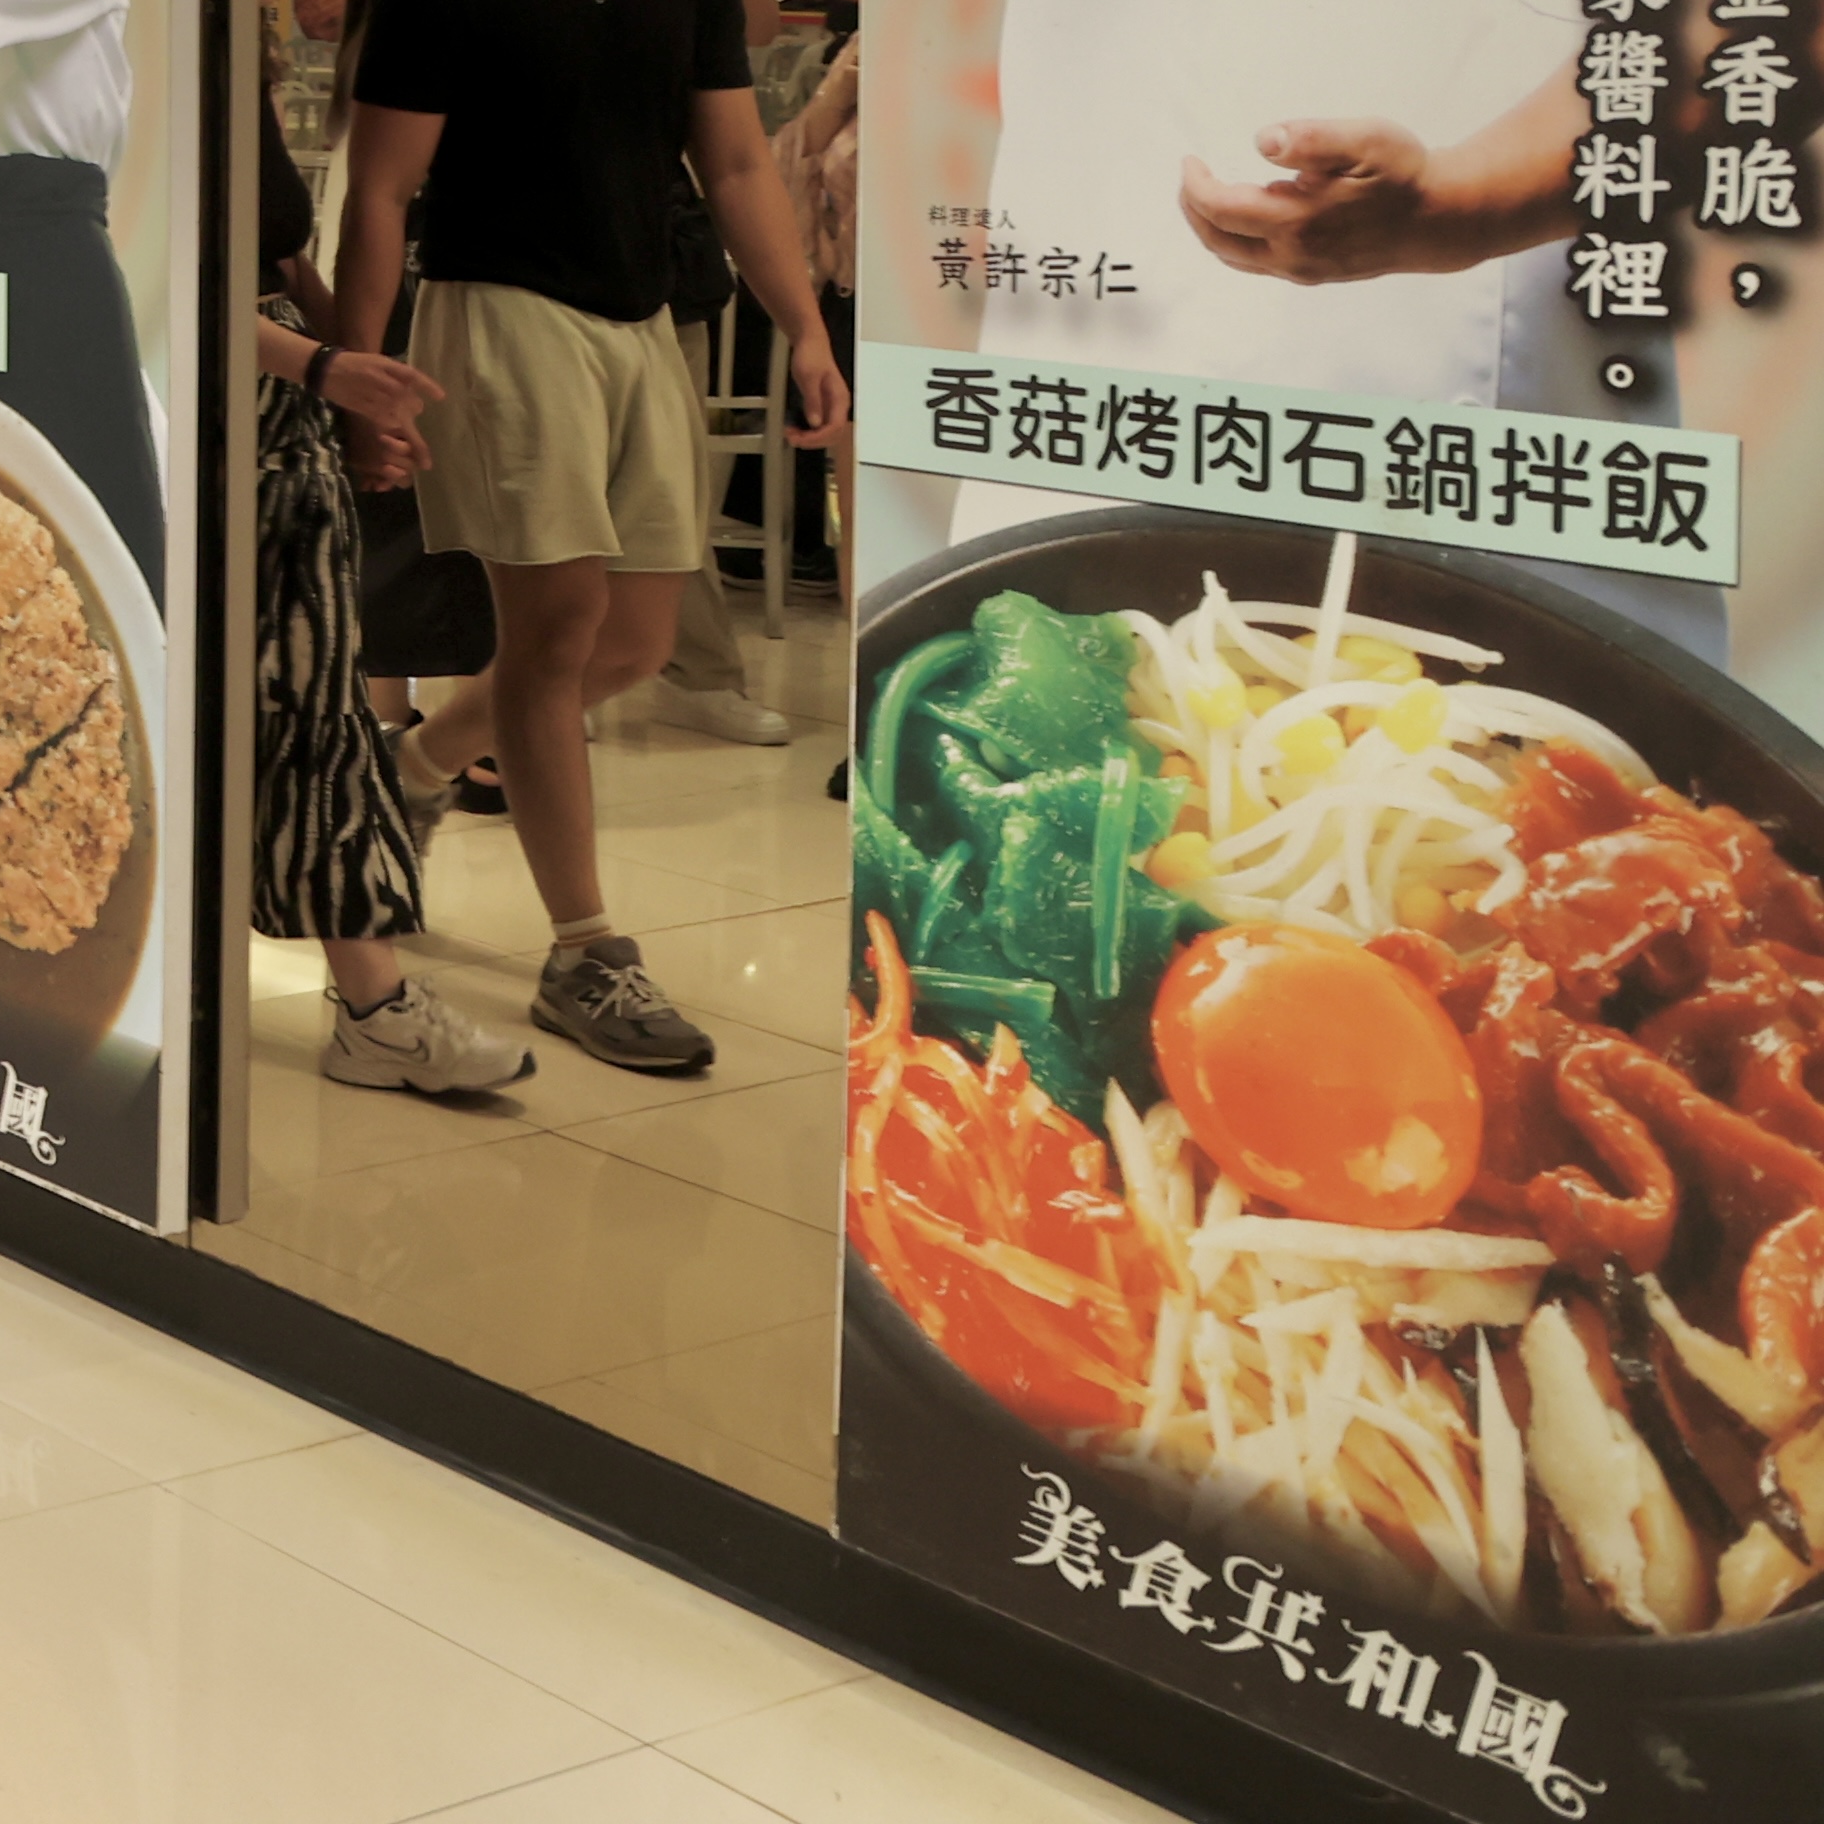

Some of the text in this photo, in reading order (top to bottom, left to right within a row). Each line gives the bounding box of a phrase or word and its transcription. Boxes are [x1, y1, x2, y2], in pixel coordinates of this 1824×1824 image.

[928, 204, 1016, 230] 料理達人
[931, 236, 1138, 301] 黃許宗仁
[925, 367, 1712, 554] 香菇烤肉石鍋拌飯
[1013, 1462, 1607, 1820] 美食共和國
